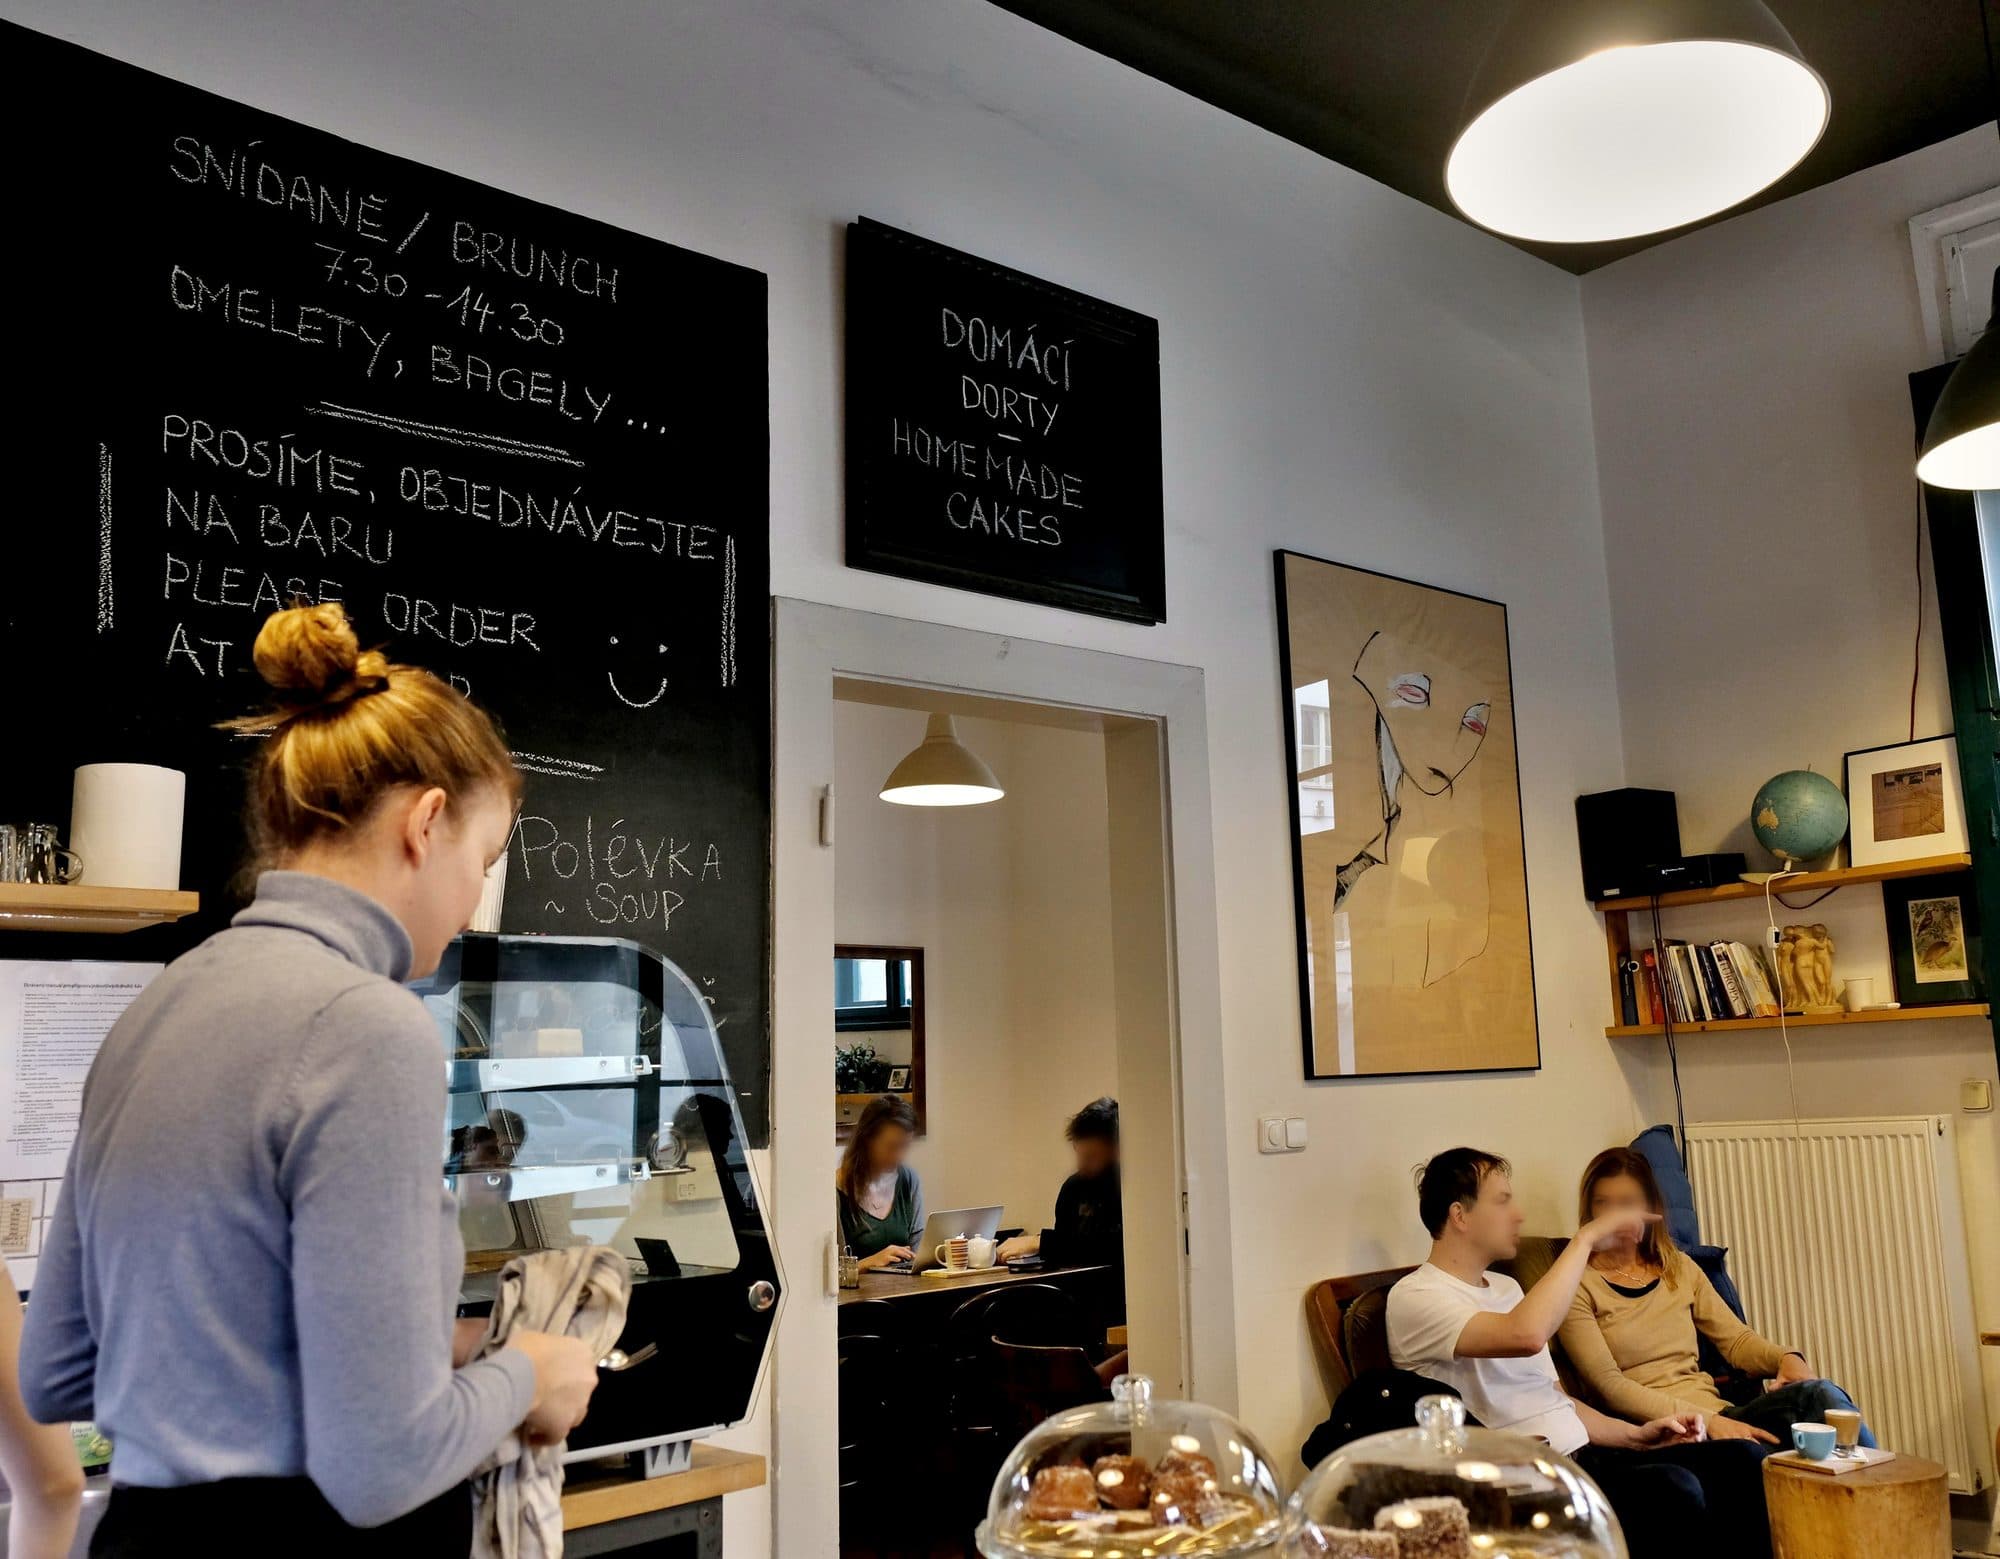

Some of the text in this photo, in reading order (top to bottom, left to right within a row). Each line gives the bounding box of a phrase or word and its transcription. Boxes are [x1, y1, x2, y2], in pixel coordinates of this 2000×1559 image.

[452, 221, 618, 301] BRUNCH
[170, 264, 403, 378] OMELETY,
[942, 307, 1074, 391] DOMÁCÍ
[961, 375, 1059, 436] DORTY
[163, 414, 715, 560] PROSÍME, OBJEDNÁVEJTE
[166, 487, 393, 564] NA BARU
[946, 492, 1062, 546] CAKES
[166, 622, 233, 678] AT
[383, 592, 541, 652] ORDER
